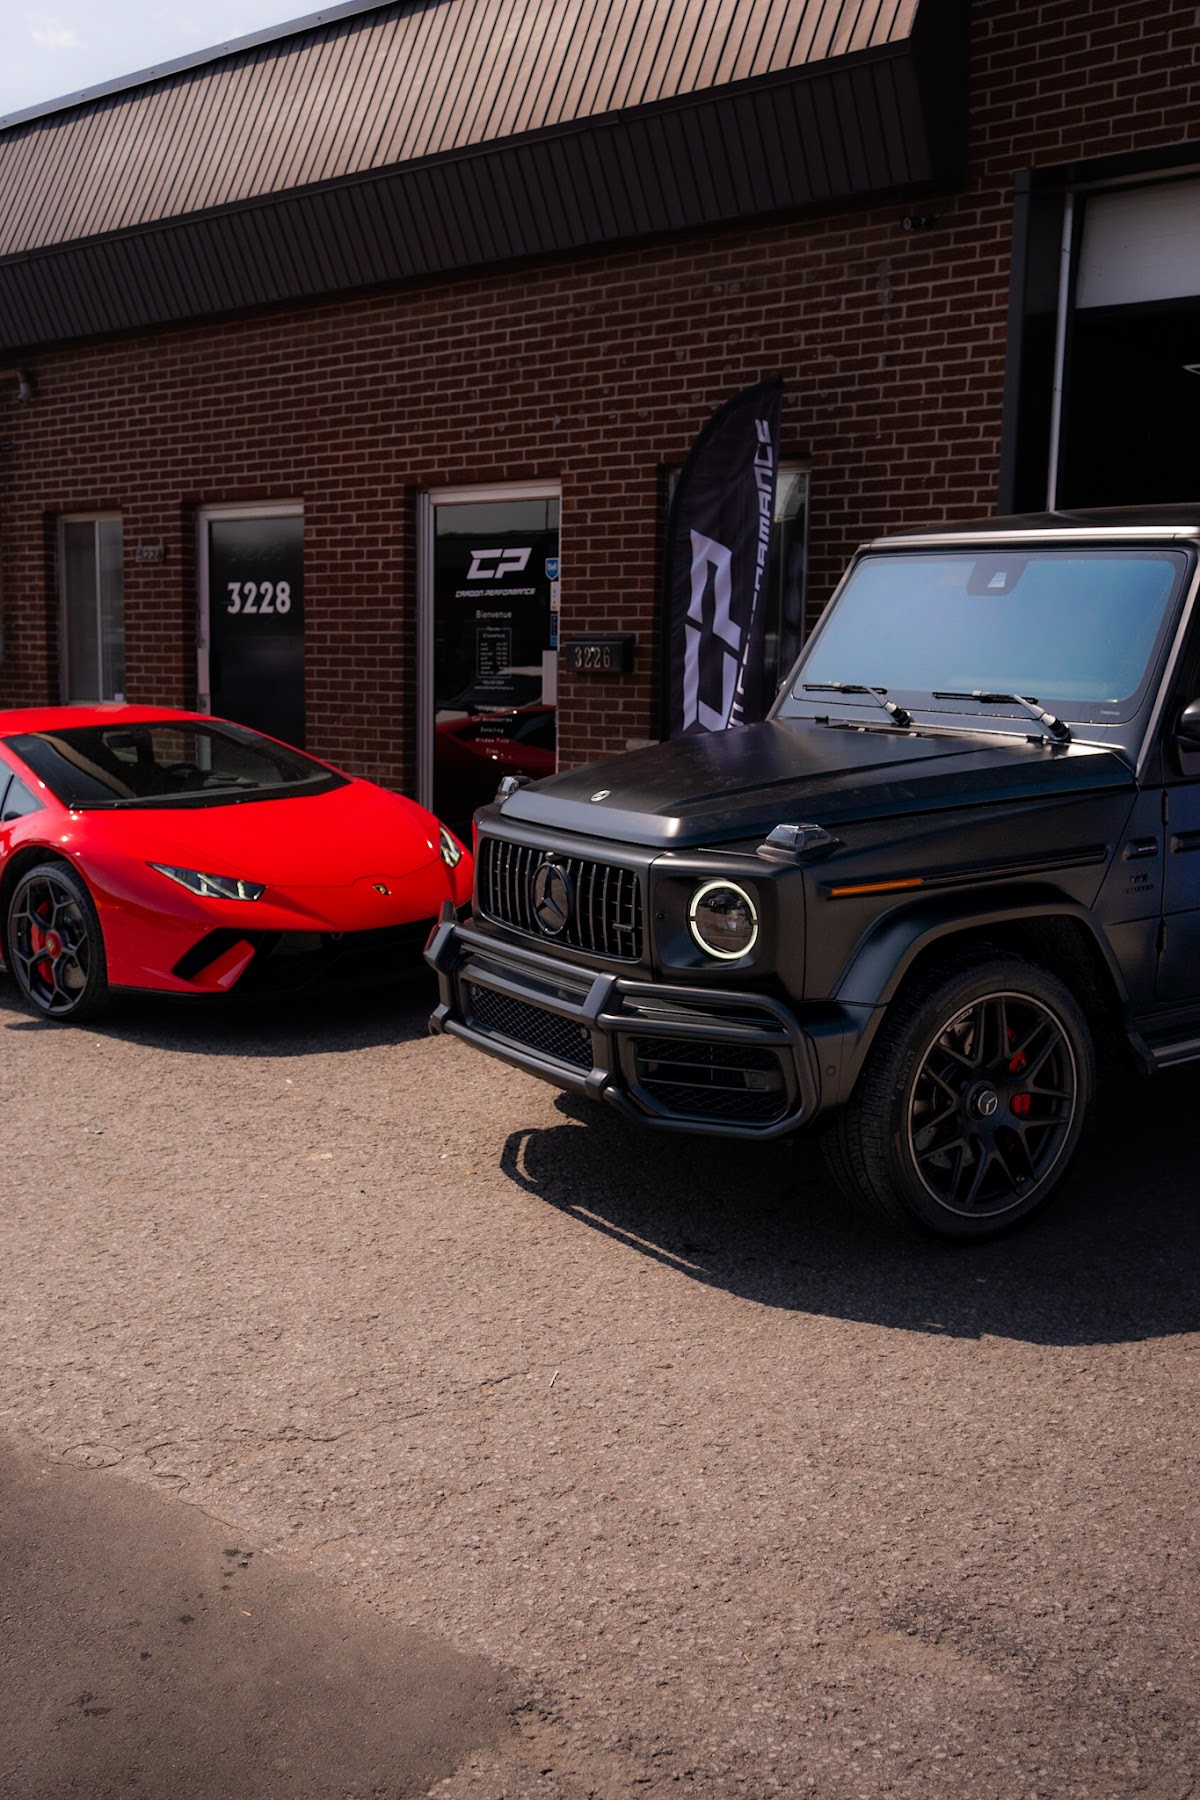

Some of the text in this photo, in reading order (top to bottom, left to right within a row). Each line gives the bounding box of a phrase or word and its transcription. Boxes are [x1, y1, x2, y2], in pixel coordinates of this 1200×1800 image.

[466, 547, 532, 579] CP
[227, 581, 291, 614] 3228
[484, 588, 536, 597] PERFORMANCE
[476, 610, 512, 618] Bienvenue
[575, 646, 611, 669] 3226
